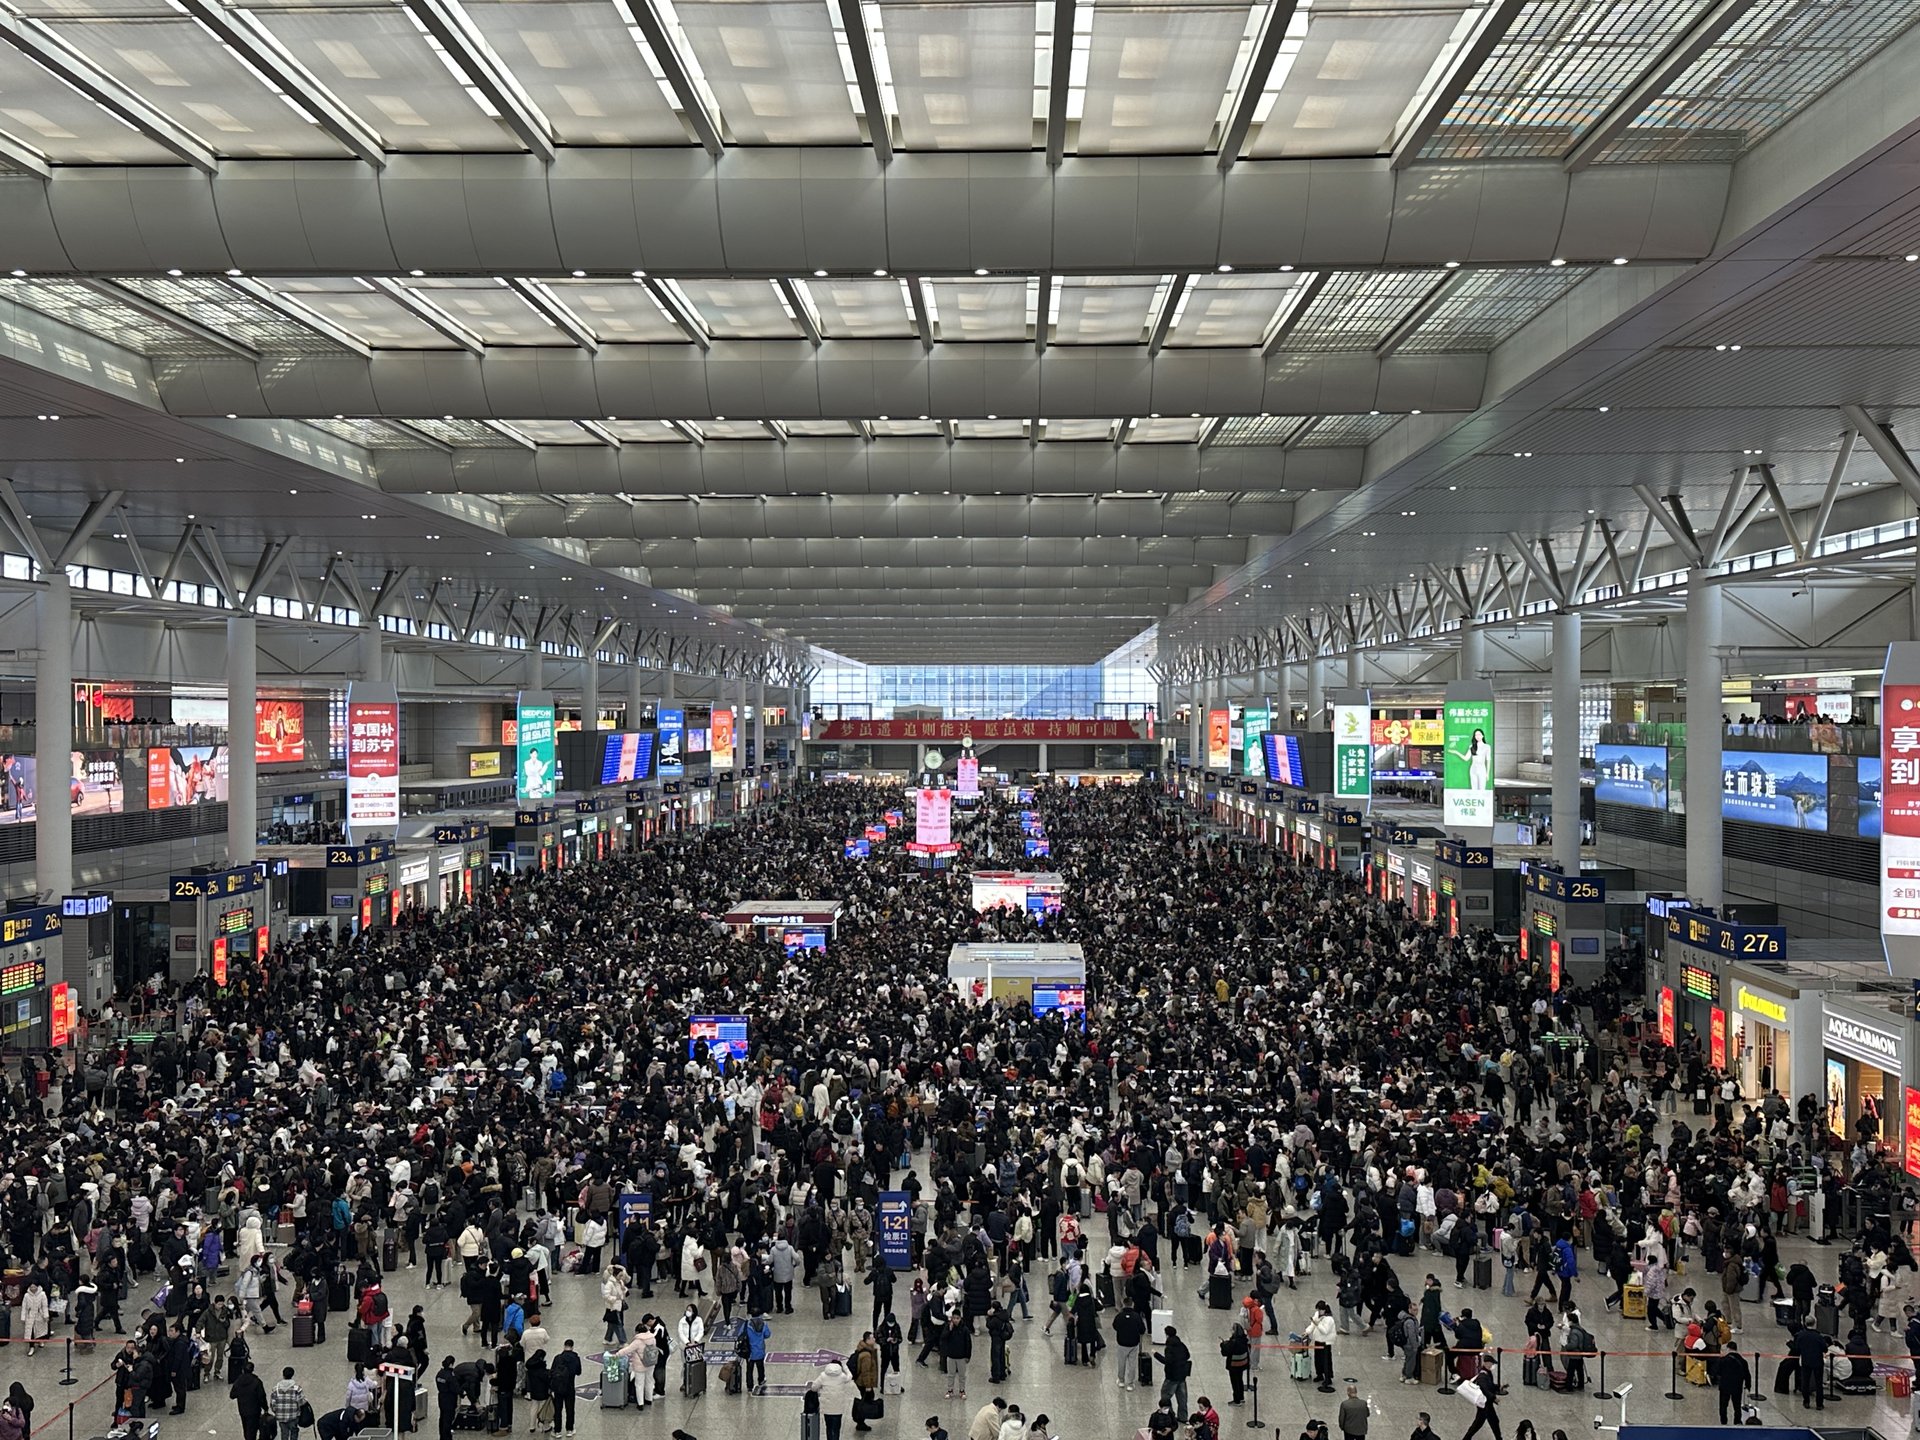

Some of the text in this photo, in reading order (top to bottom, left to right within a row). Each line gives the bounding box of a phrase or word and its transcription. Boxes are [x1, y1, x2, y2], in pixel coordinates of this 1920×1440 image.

[352, 723, 395, 737] 享国补
[841, 722, 892, 737] 梦虽遥
[904, 722, 972, 737] 追则能达
[985, 722, 1036, 737] 愿虽艰
[352, 739, 395, 753] 到苏宁
[1890, 725, 1920, 753] 享
[1348, 748, 1357, 787] 让家更好
[1357, 748, 1366, 777] 兔宝宝
[1890, 758, 1920, 785] 到
[578, 802, 592, 811] 17A
[1453, 799, 1485, 807] VASEN
[519, 814, 534, 824] 19A
[1460, 808, 1477, 816] 伟星
[1342, 815, 1358, 824] 19B
[438, 830, 457, 840] 21A
[1394, 831, 1414, 840] 21B
[331, 852, 352, 863] 23A
[1466, 852, 1489, 864] 23B
[175, 881, 201, 896] 25A
[1572, 883, 1599, 897] 25B
[45, 913, 61, 930] 26A
[1720, 930, 1735, 951] 27B
[1743, 934, 1779, 952] 27B
[882, 1215, 909, 1230] 1-21
[883, 1231, 908, 1241] 检票口
